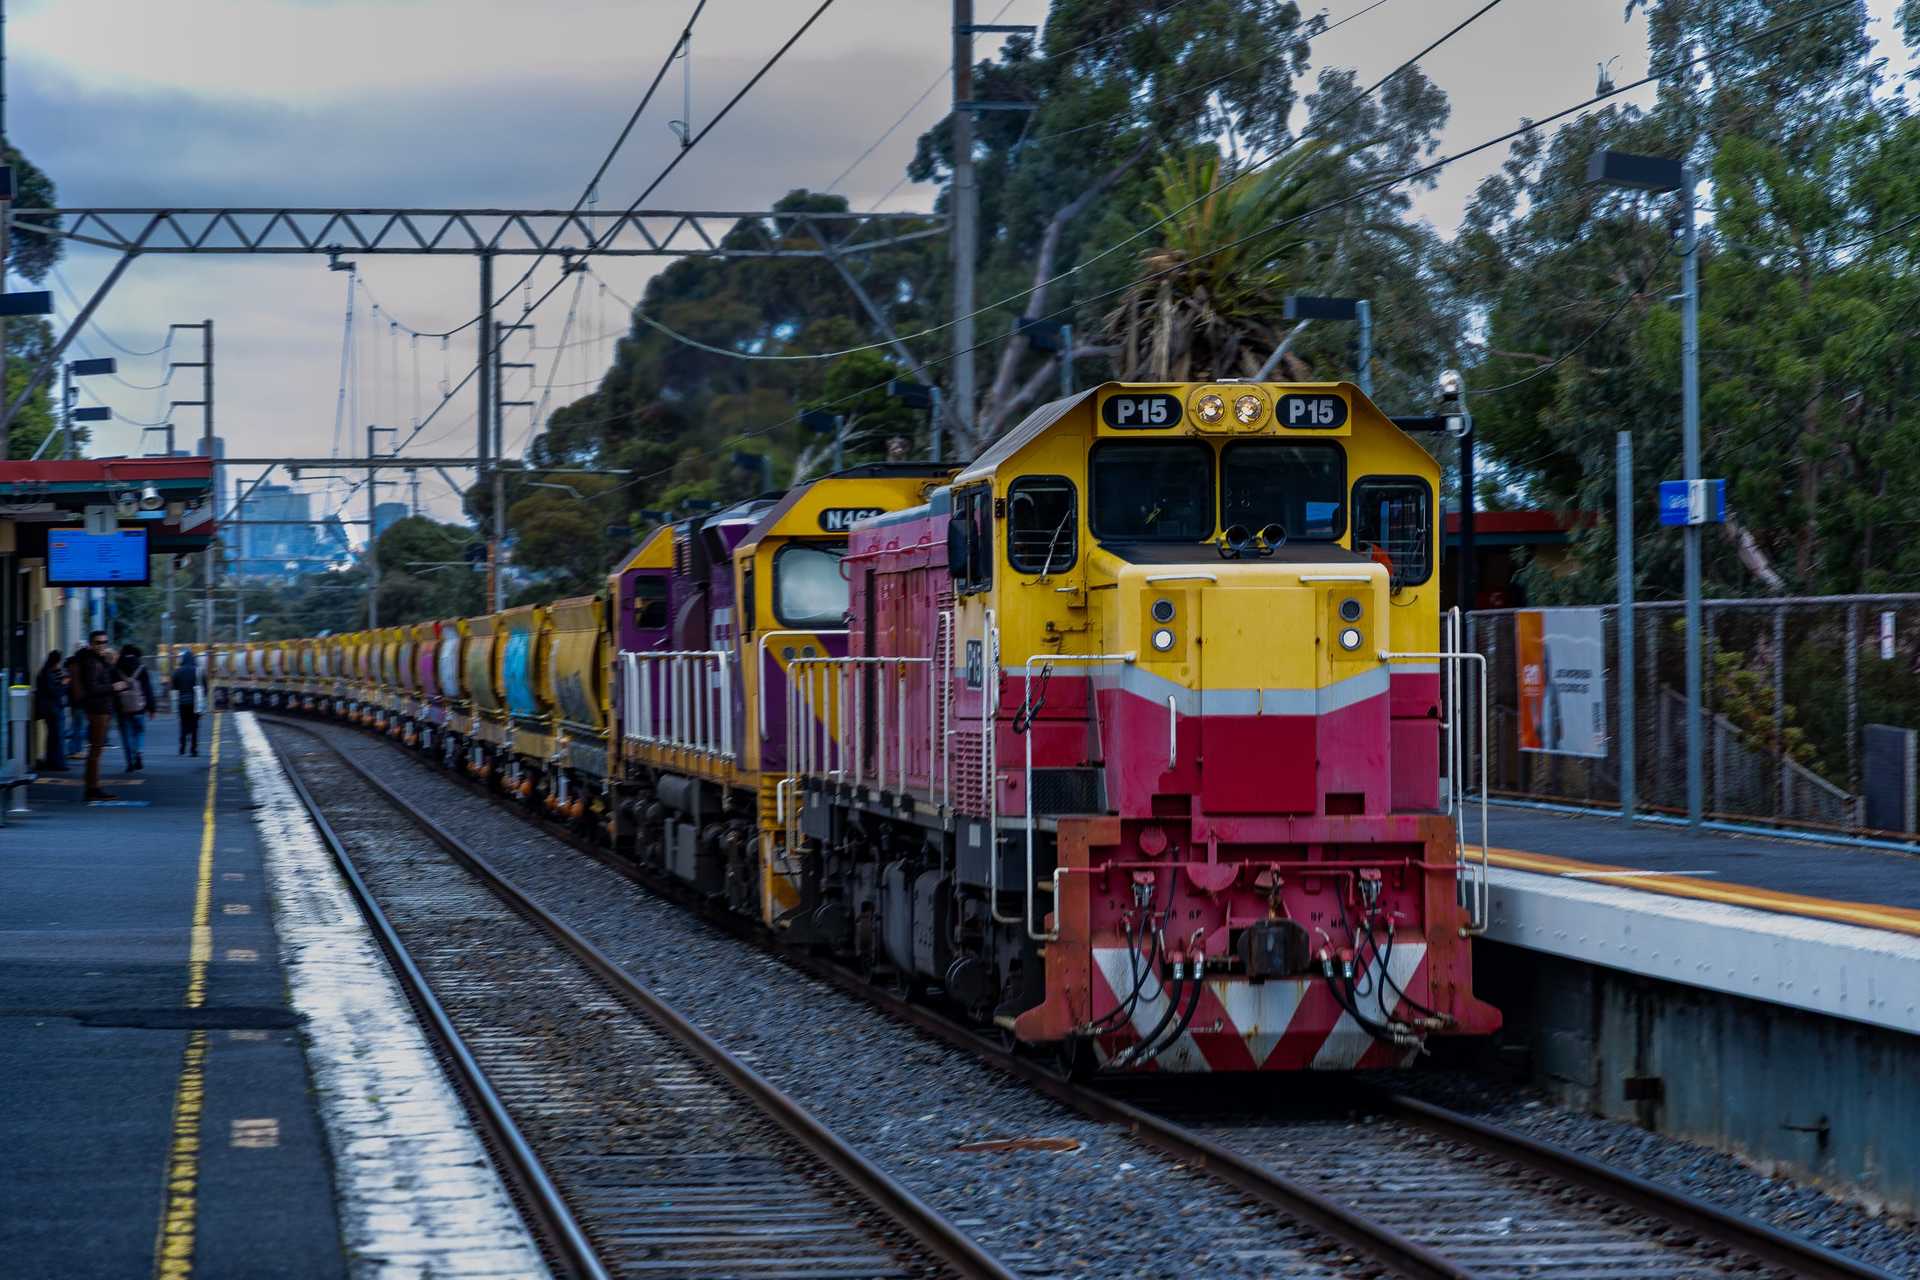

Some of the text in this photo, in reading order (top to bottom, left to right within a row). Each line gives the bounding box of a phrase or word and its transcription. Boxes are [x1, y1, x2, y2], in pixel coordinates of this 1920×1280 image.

[1117, 398, 1168, 424] P15
[1289, 398, 1335, 424] P15
[967, 642, 981, 683] P15
